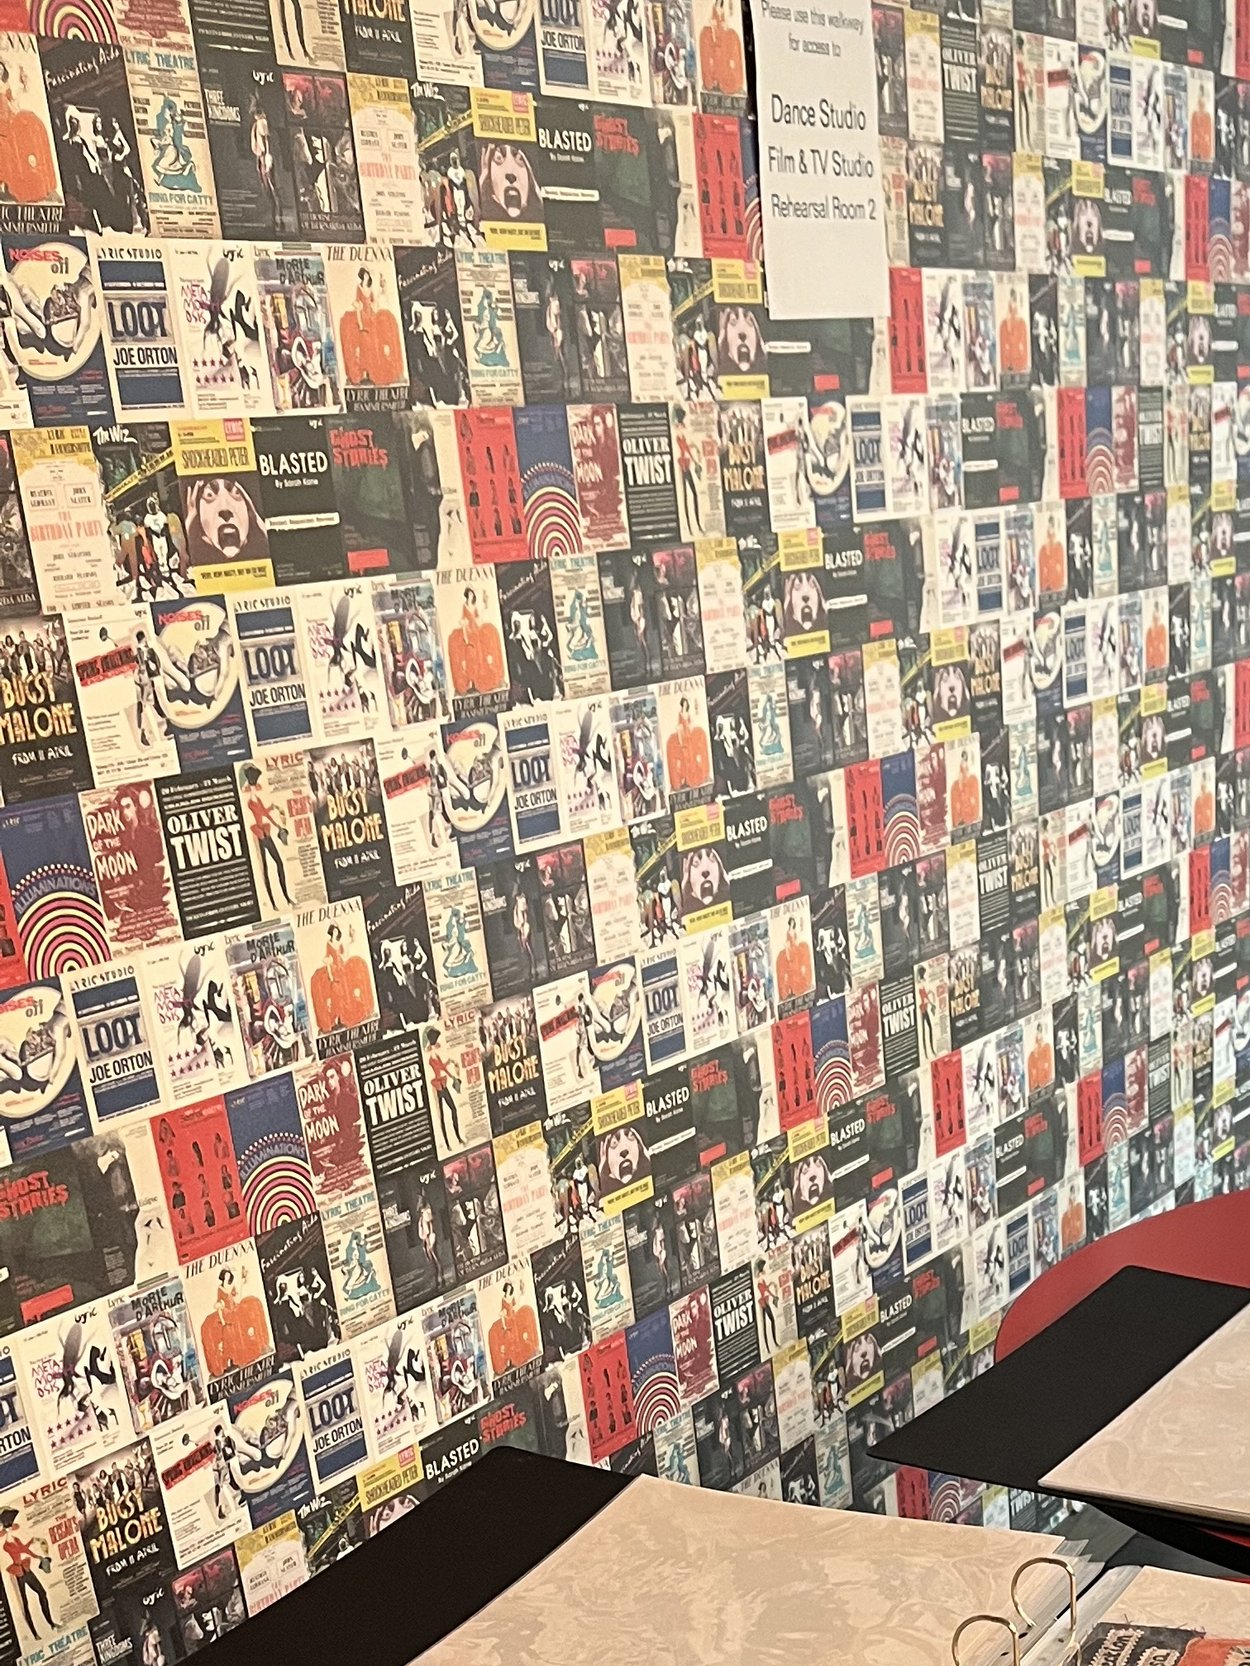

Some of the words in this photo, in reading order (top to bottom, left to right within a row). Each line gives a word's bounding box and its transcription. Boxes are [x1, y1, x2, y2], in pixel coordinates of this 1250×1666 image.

[761, 1, 791, 21] Please
[794, 10, 808, 24] use
[811, 8, 826, 26] this
[828, 12, 864, 35] walkway
[788, 32, 800, 51] for
[802, 38, 829, 56] access
[832, 40, 841, 57] to
[772, 94, 816, 126] Dance
[819, 98, 866, 130] Studio
[768, 146, 795, 173] Film
[799, 149, 807, 173] &
[811, 149, 828, 174] TV
[833, 151, 874, 178] Studio
[772, 194, 829, 219] Rehearsal
[832, 196, 865, 220] Room
[869, 198, 876, 220] 2
[107, 302, 167, 337] LOOT
[113, 348, 135, 366] JOE
[138, 346, 178, 366] ORTON
[260, 452, 328, 476] BLASTED
[87, 809, 126, 840] DARK
[167, 805, 238, 835] OLIVER
[726, 816, 768, 842] BLASTED
[170, 825, 243, 871] TWIST
[97, 851, 139, 883] MOON
[363, 1063, 421, 1097] OLIVER
[365, 1080, 425, 1126] TWIST
[308, 1388, 356, 1432] LOOT
[425, 1438, 480, 1480] BLASTED
[22, 1476, 68, 1504] LYRIC
[90, 1508, 163, 1565] MALONE
